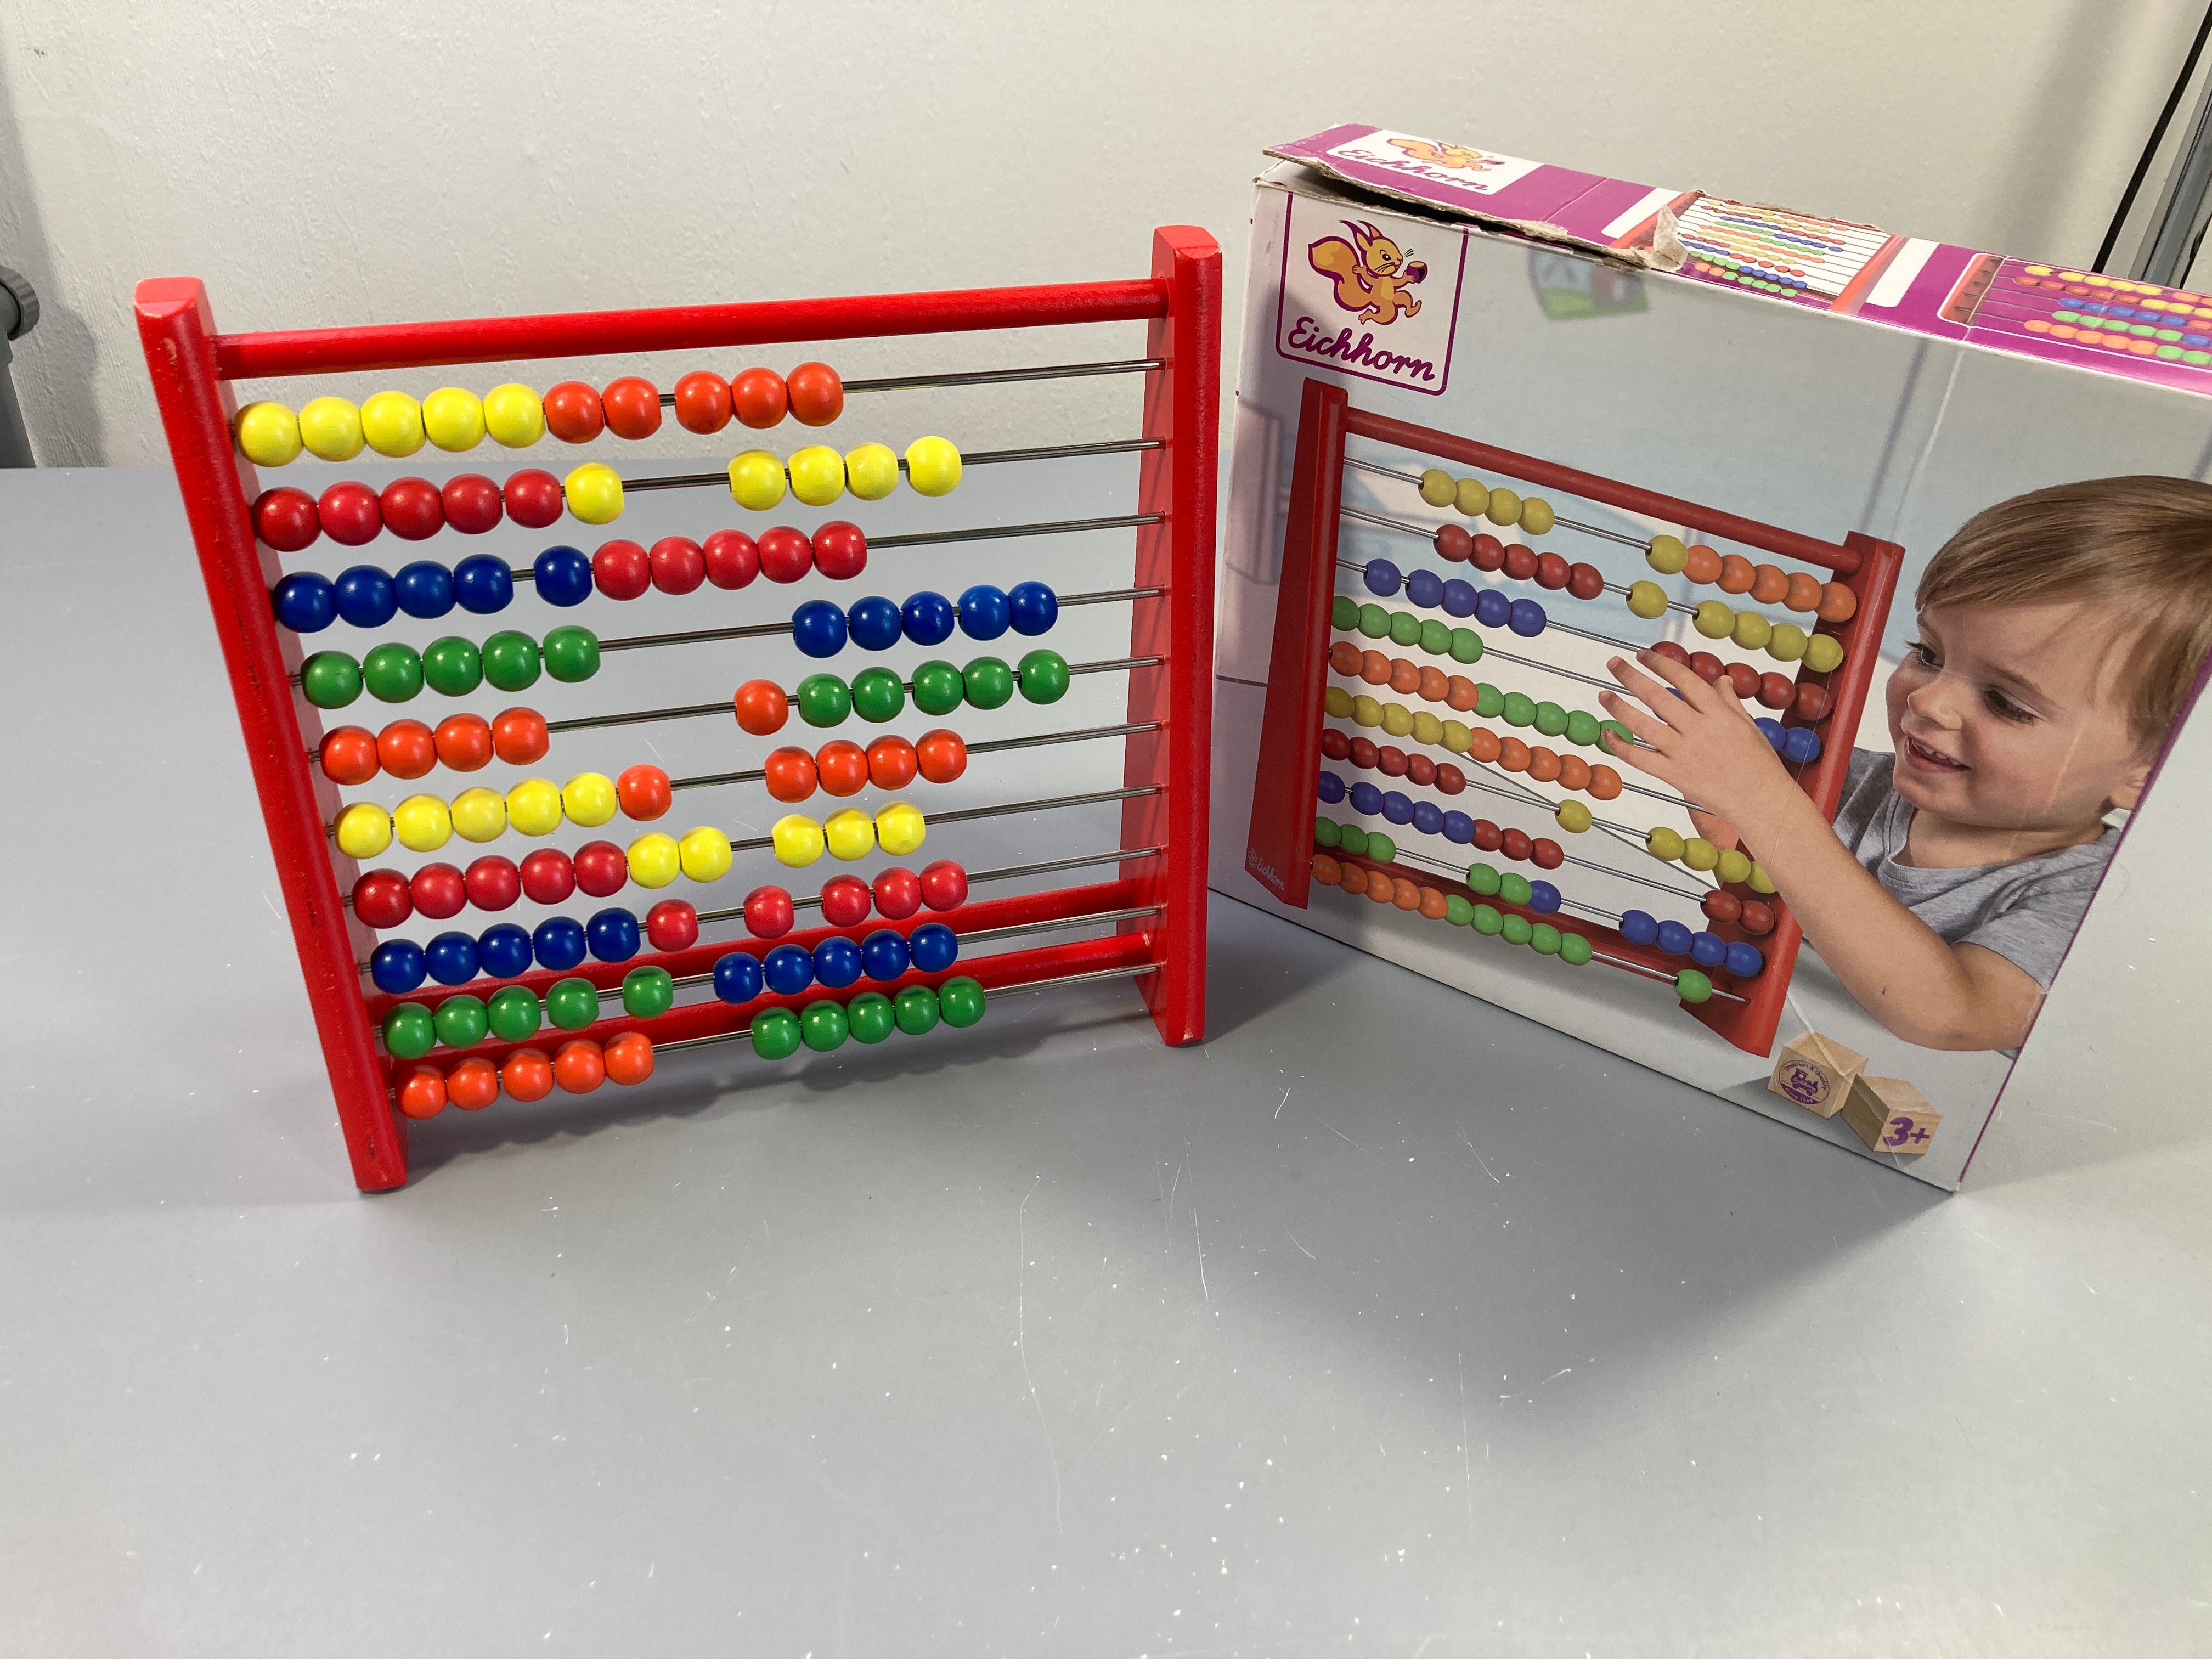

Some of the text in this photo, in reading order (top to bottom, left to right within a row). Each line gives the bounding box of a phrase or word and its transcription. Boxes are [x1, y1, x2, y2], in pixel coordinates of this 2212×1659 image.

[1338, 149, 1488, 191] Eichhorn
[1288, 316, 1435, 381] Eichhorn
[1257, 857, 1284, 890] Eichhorn
[1784, 1062, 1808, 1071] Tradition
[1815, 1070, 1827, 1090] Quality
[1882, 1116, 1930, 1147] 3+
